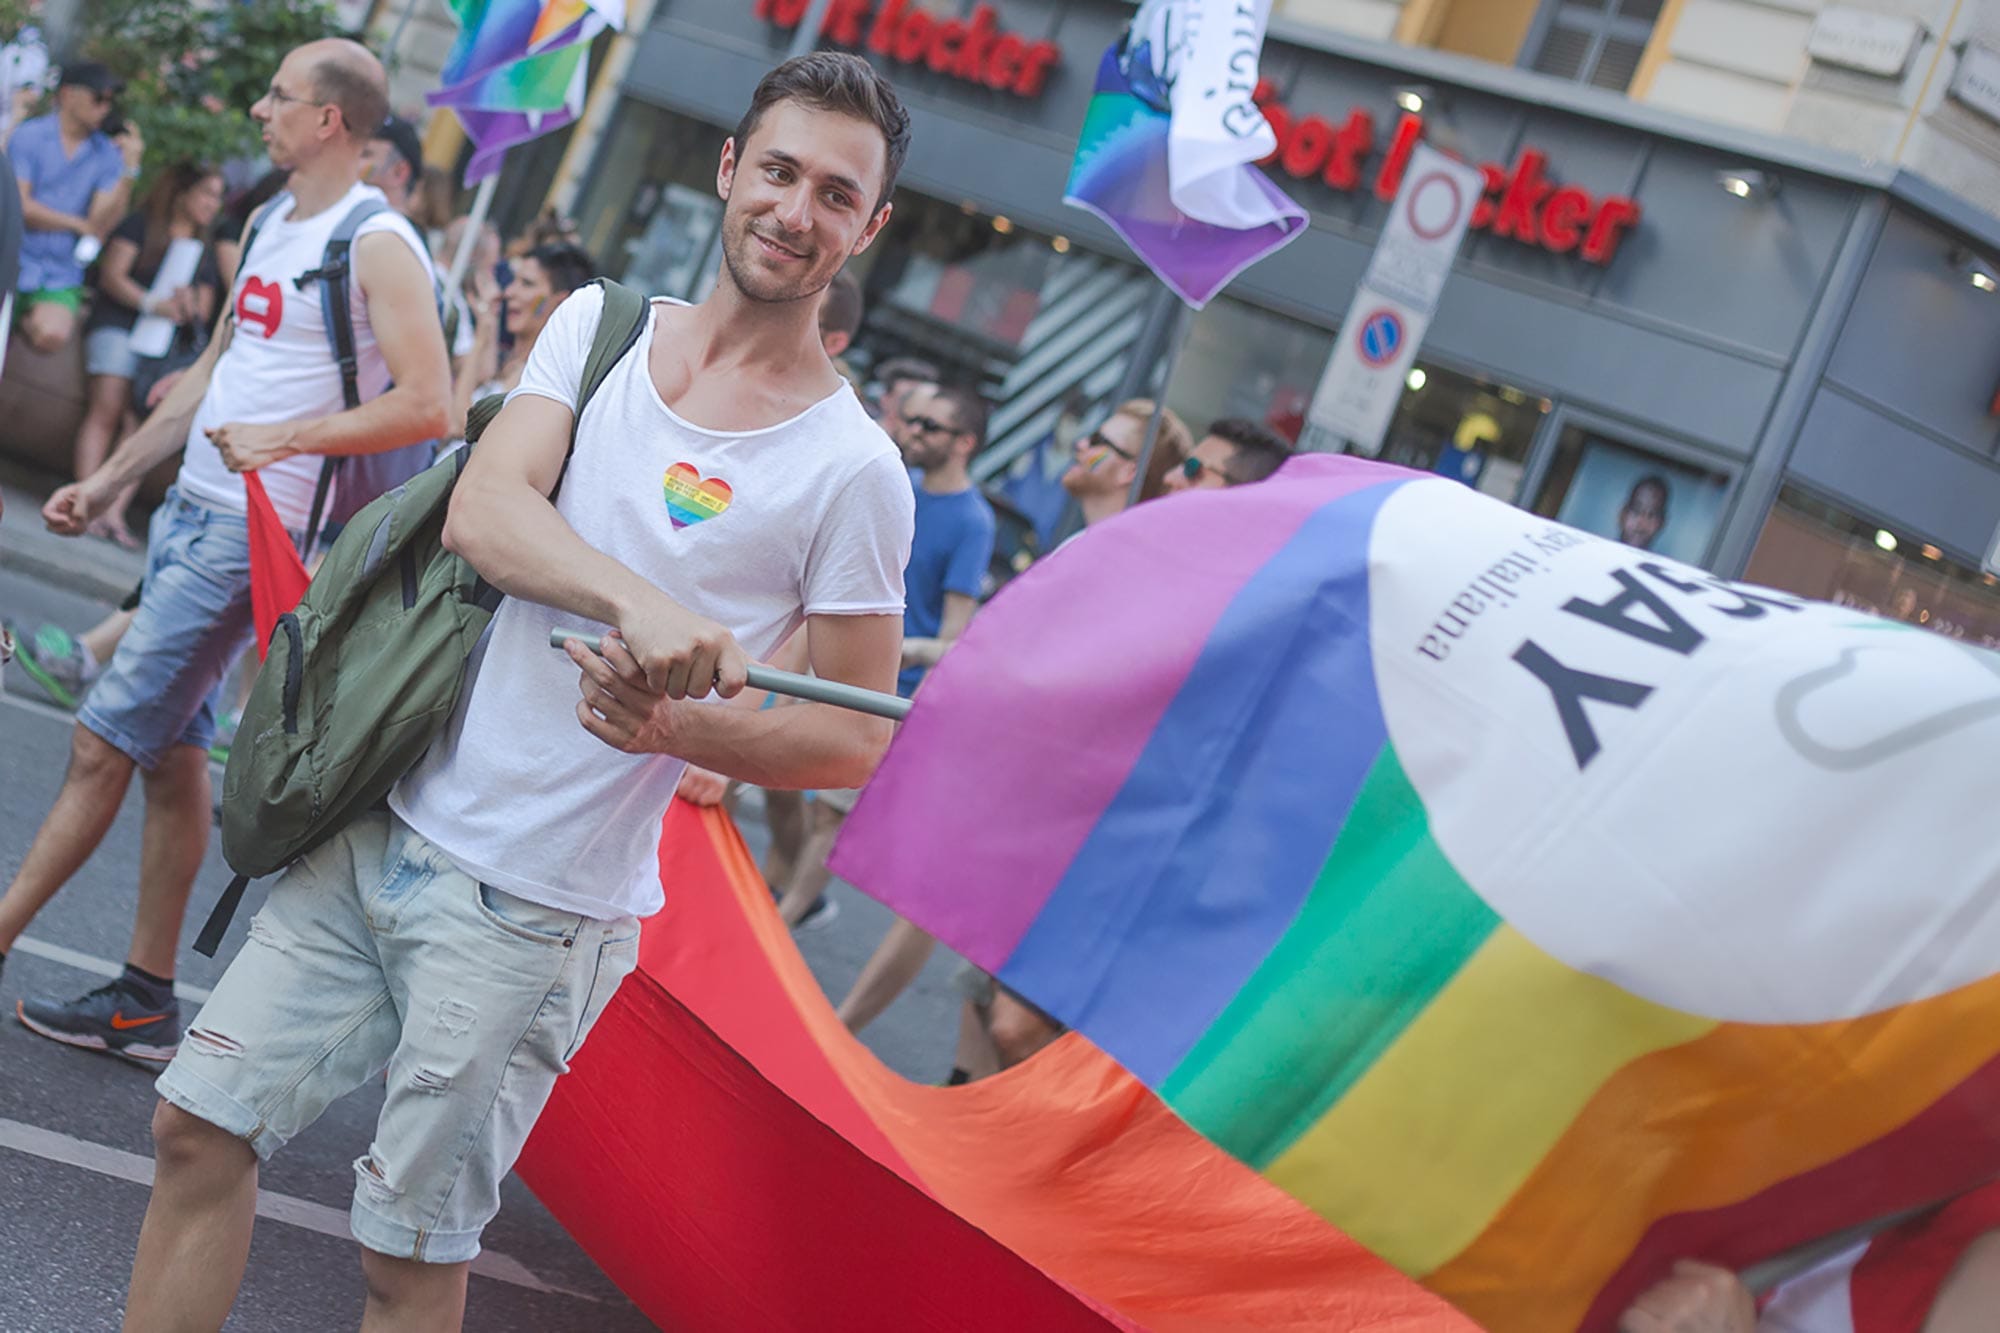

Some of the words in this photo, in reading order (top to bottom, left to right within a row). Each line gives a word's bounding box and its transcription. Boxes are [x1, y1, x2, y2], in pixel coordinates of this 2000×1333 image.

[868, 0, 1060, 96] locker
[1374, 113, 1642, 265] lcker
[1416, 551, 1552, 661] italiana
